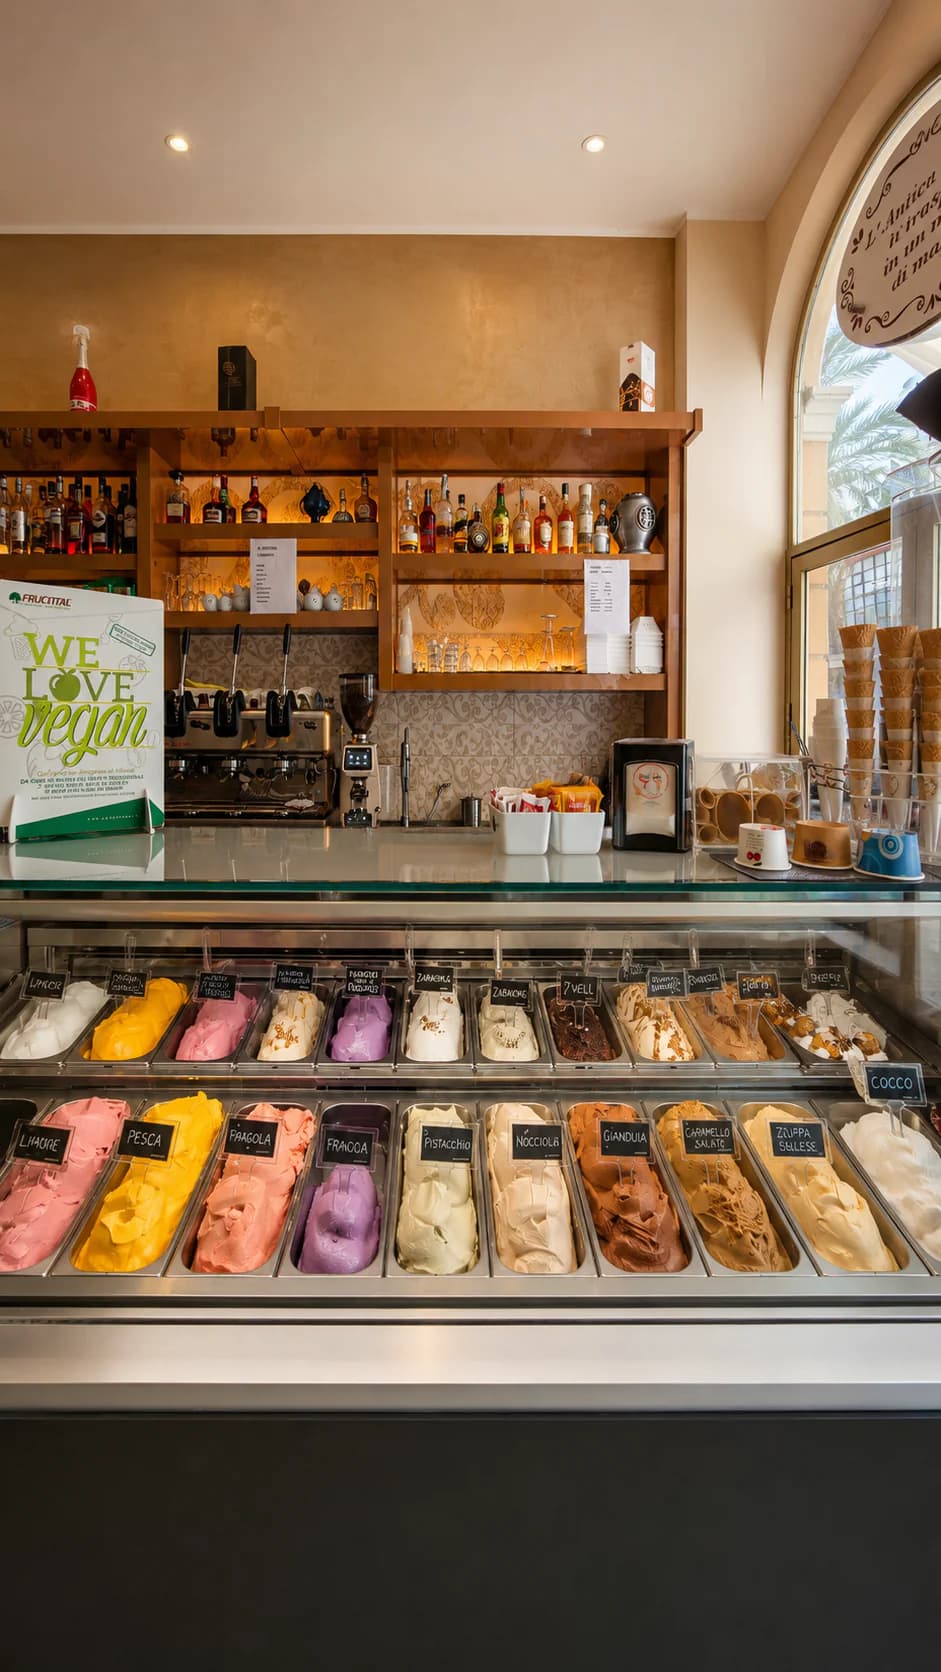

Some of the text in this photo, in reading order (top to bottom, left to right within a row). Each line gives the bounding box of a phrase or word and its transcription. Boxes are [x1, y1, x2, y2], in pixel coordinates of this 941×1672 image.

[904, 229, 925, 257] un
[891, 264, 908, 292] di
[23, 632, 100, 668] WE
[22, 667, 135, 702] LOVE
[17, 702, 148, 768] vegan
[871, 1076, 913, 1090] COCCO
[126, 1129, 162, 1147] PESCA
